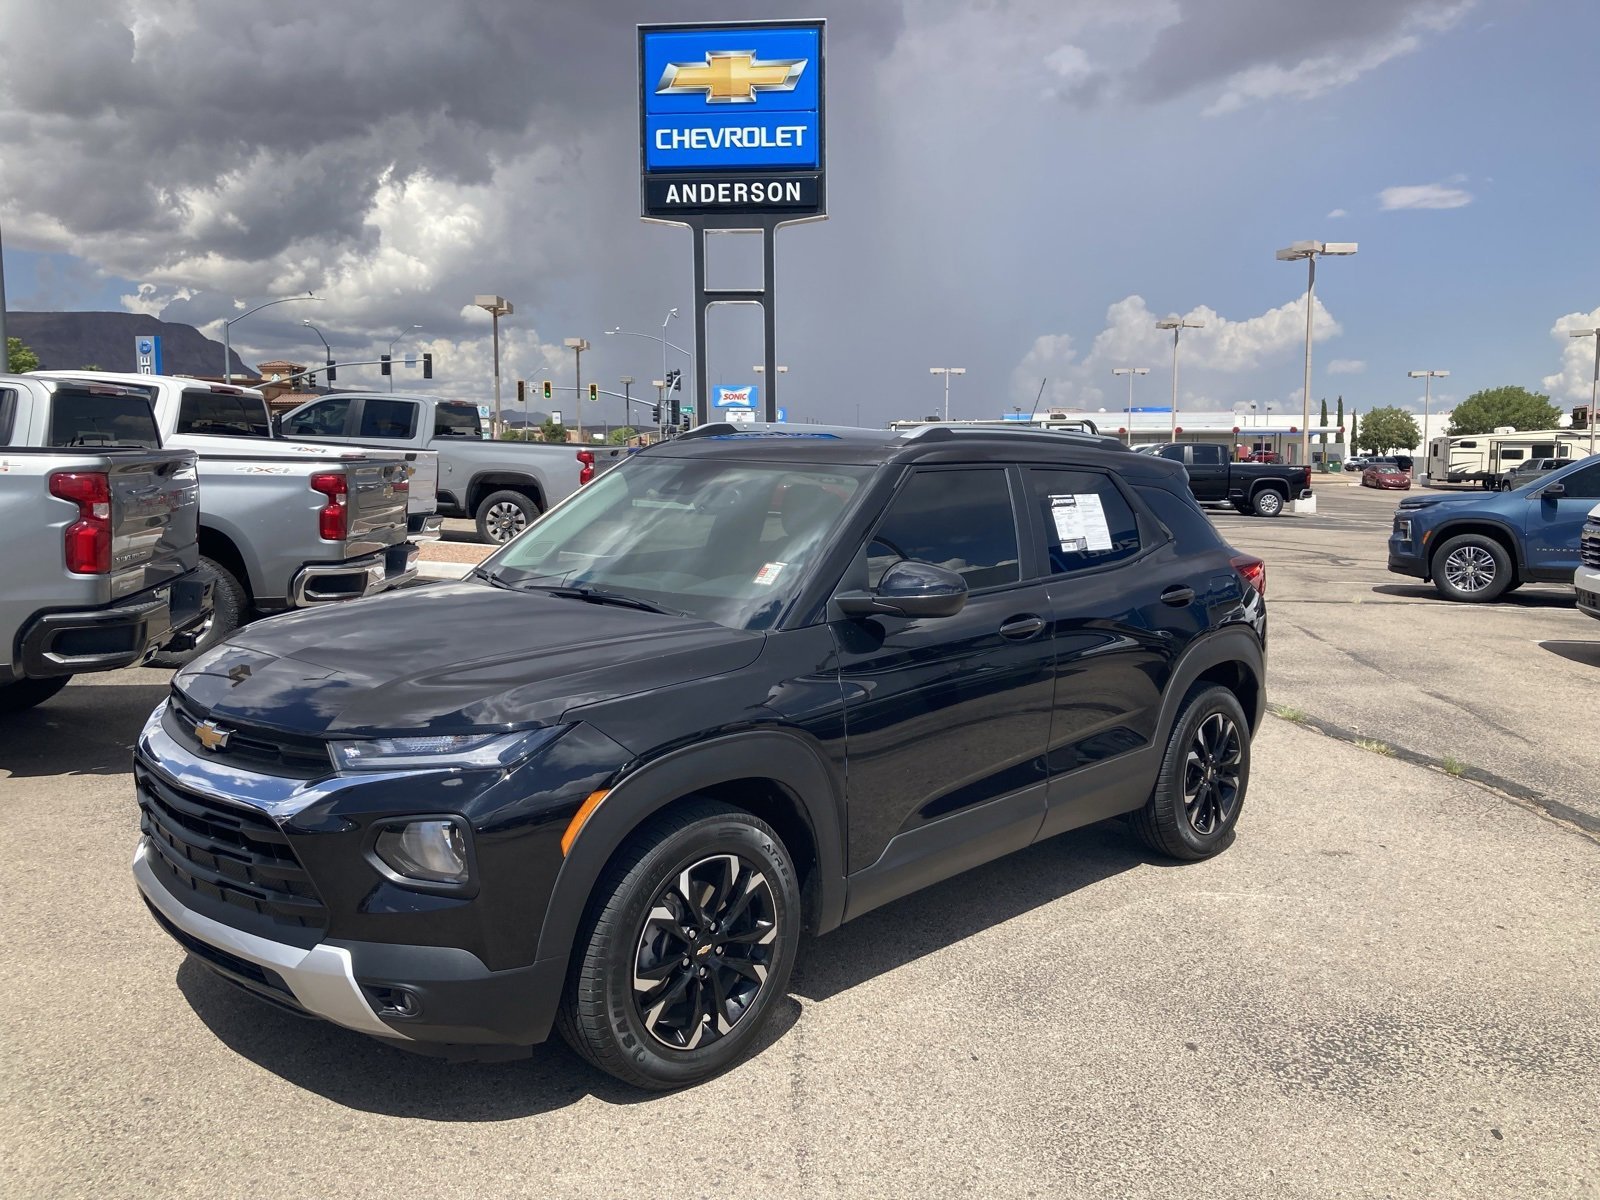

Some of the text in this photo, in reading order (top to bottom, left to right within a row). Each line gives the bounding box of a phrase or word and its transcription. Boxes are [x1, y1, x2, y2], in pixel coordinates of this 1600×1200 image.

[655, 126, 807, 150] CHEVROLET
[666, 182, 801, 204] ANDERSON
[723, 393, 748, 401] SONIC
